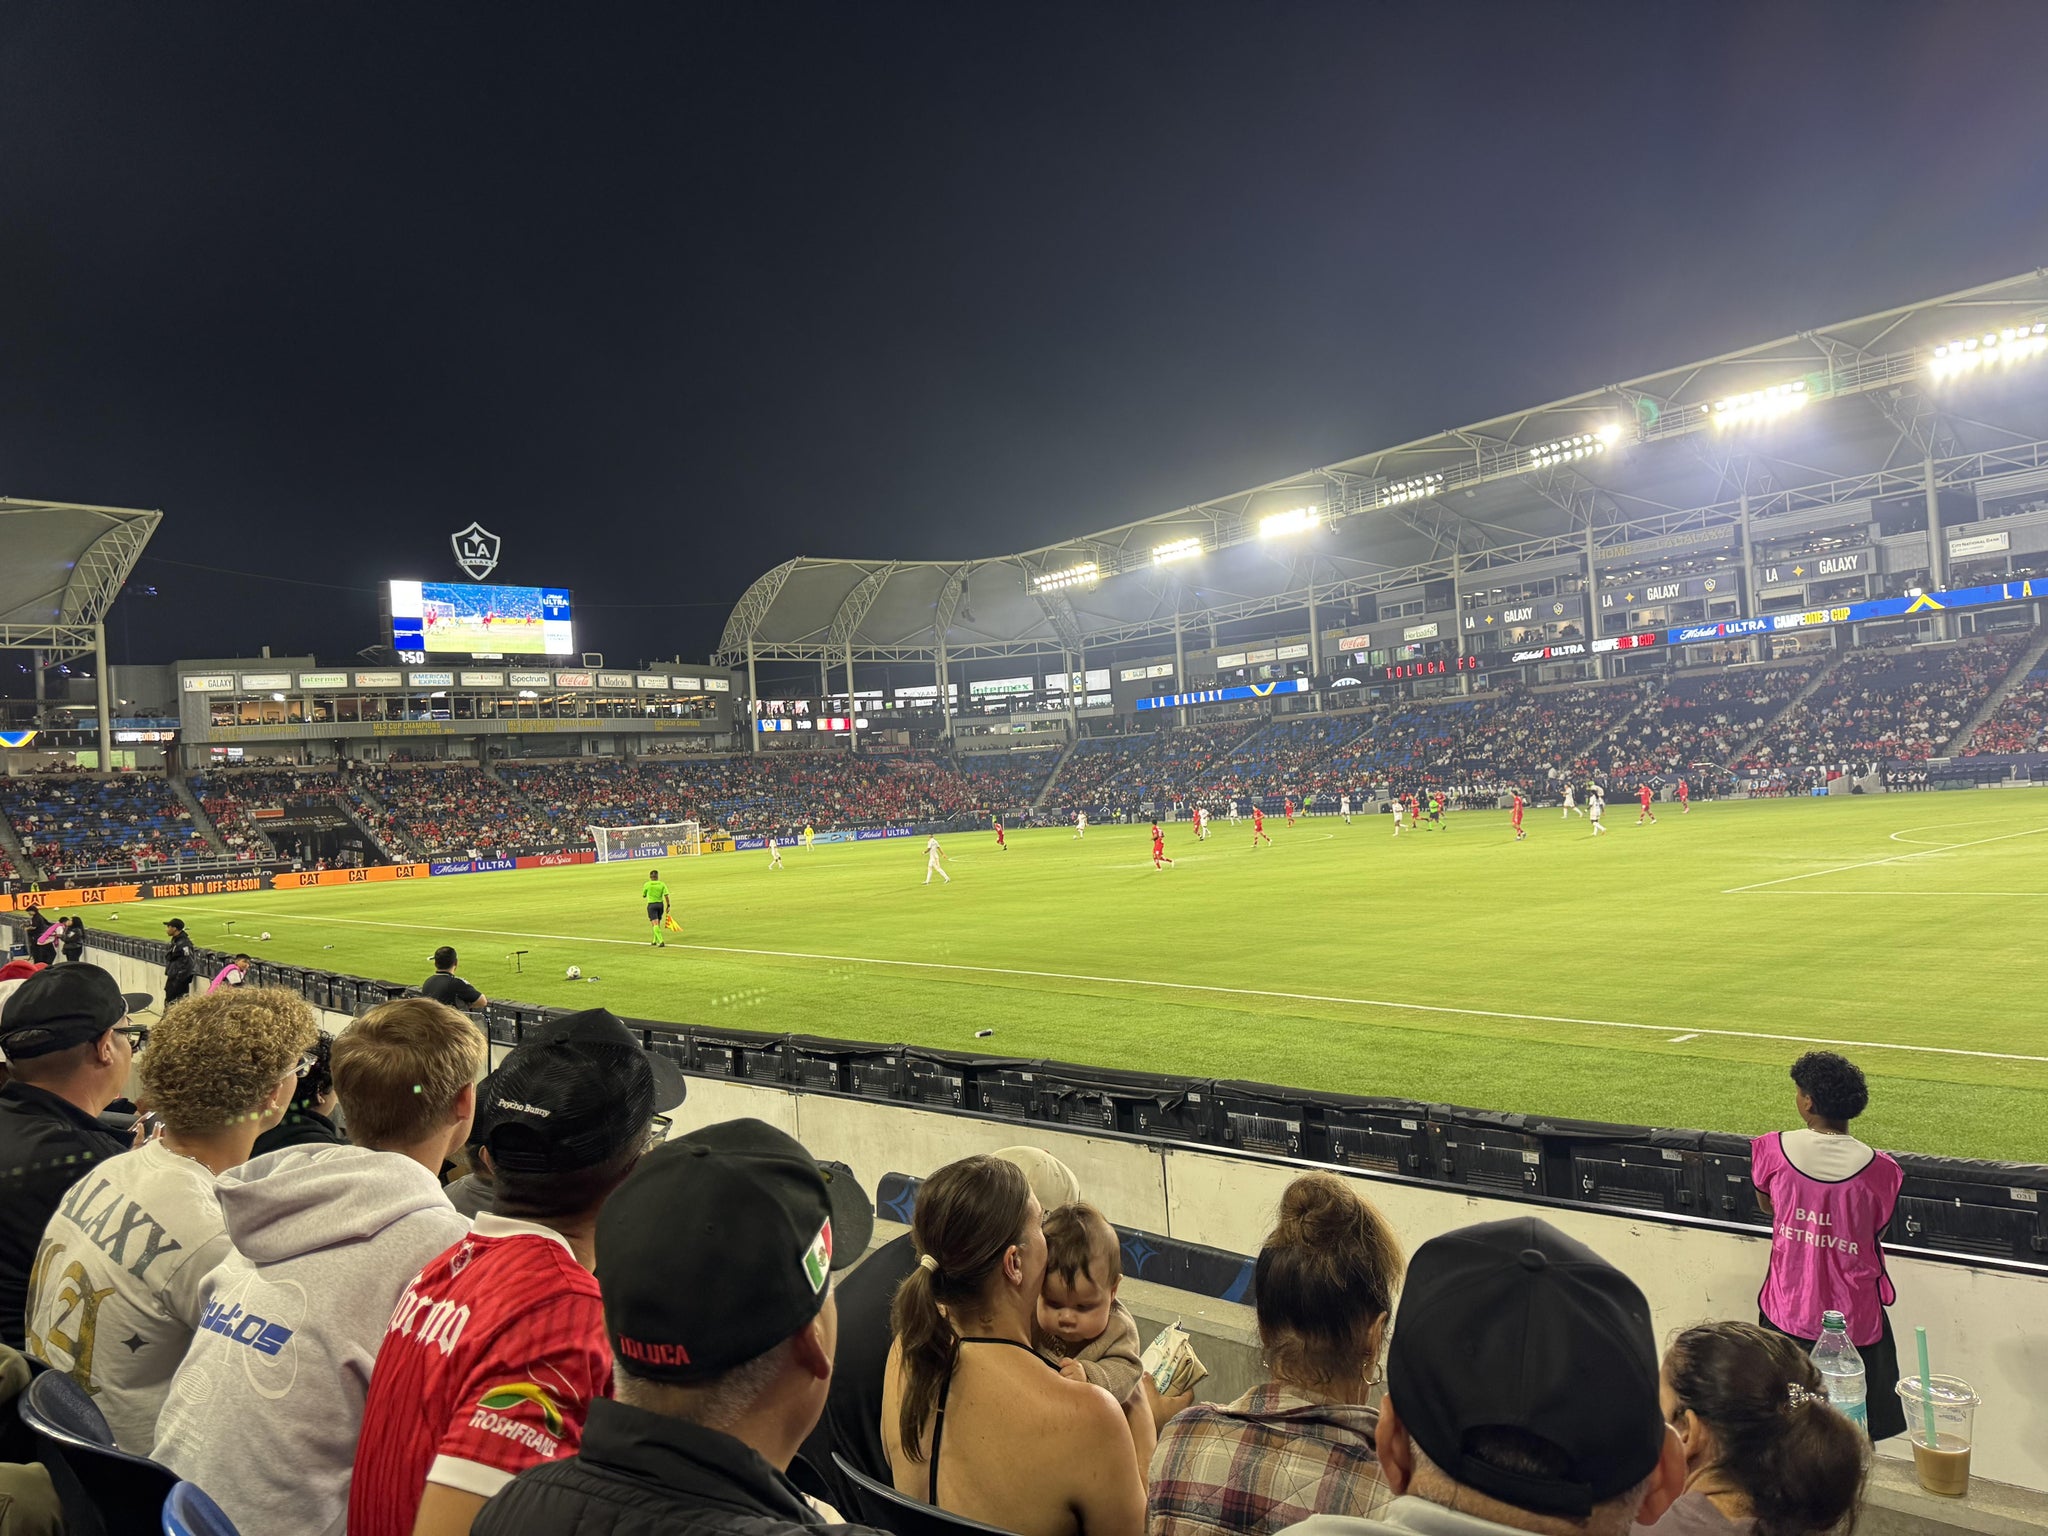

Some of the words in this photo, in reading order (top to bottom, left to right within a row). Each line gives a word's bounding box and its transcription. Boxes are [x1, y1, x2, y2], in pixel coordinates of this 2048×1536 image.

[464, 542, 491, 558] LA
[1766, 568, 1779, 583] LA
[1819, 555, 1858, 574] GALAXY
[1602, 595, 1613, 607] LA
[1647, 584, 1680, 600] GALAXY
[2002, 581, 2033, 600] LA
[543, 598, 569, 606] ULTRA
[1465, 616, 1475, 629] LA
[1504, 608, 1533, 623] GALAXY
[1725, 619, 1767, 633] ULTRA
[1773, 610, 1830, 629] CAMPEONES
[1830, 607, 1851, 622] CUP
[1405, 629, 1434, 640] Herbalife
[1551, 644, 1586, 657] ULTRA
[1638, 634, 1656, 647] CUP
[1386, 660, 1446, 680] TOLUCA
[1457, 656, 1477, 670] FC
[184, 680, 193, 689] LA
[208, 679, 233, 688] GALAXY
[511, 675, 546, 684] Spectrum
[603, 677, 628, 687] Modelo
[972, 683, 1030, 695] intermex
[1151, 696, 1165, 709] LA
[1173, 689, 1223, 706] GALAXY
[160, 732, 175, 741] CUP
[887, 828, 911, 837] ULTRA
[634, 847, 667, 857] ULTRA
[676, 844, 692, 855] CAT
[711, 842, 725, 853] CAT
[478, 860, 512, 870] ULTRA
[539, 855, 556, 865] Old
[555, 855, 572, 865] Spice
[300, 873, 320, 885] CAT
[349, 869, 368, 882] CAT
[396, 866, 415, 878] CAT
[152, 883, 189, 898] THERE'S
[191, 881, 204, 894] NO
[207, 877, 260, 893] OFF-SEASON
[22, 893, 47, 907] CAT
[82, 889, 106, 903] CAT
[498, 1098, 524, 1112] Psycho
[524, 1104, 551, 1117] Bunny
[1795, 1207, 1833, 1226] BALL
[61, 1171, 183, 1280] ALAXY
[1778, 1223, 1859, 1255] RETRIEVER
[468, 1408, 559, 1458] ROSHFRANS
